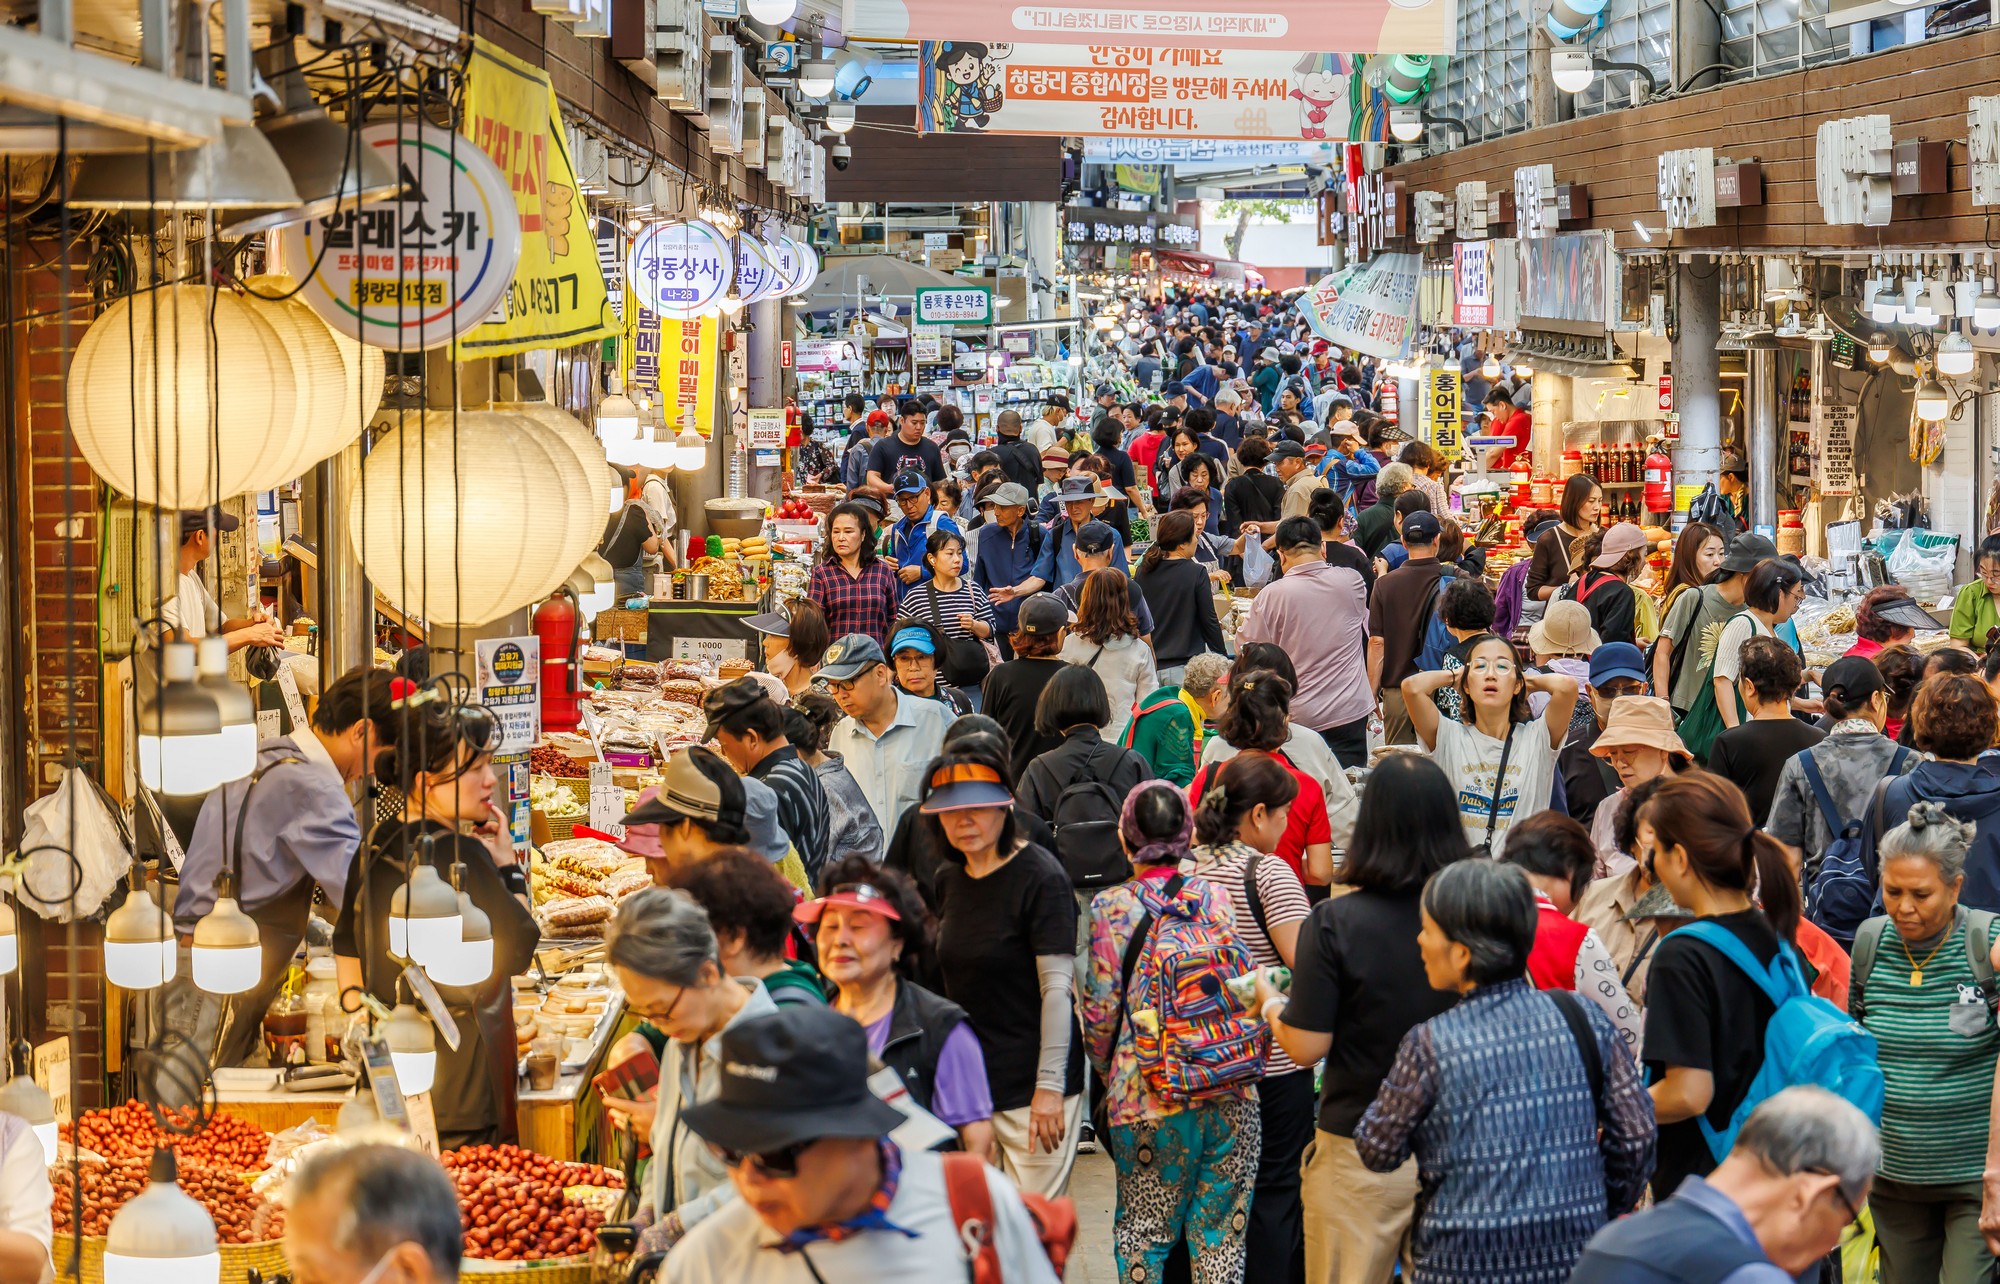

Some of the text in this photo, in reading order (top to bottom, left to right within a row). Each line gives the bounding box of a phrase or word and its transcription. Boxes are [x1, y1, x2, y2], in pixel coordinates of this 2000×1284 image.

[1009, 69, 1067, 95] 청량리
[1172, 77, 1228, 100] 방문해
[1231, 77, 1287, 101] 주셔서
[1100, 106, 1198, 130] 감사합니다.
[319, 209, 479, 250] 알래스카
[338, 255, 395, 271] 프리미엄
[643, 257, 720, 280] 경동상사
[1435, 374, 1457, 446] 홍어무침
[697, 641, 723, 650] 10000
[1465, 784, 1483, 794] HOPE
[1460, 794, 1488, 810] Daisy
